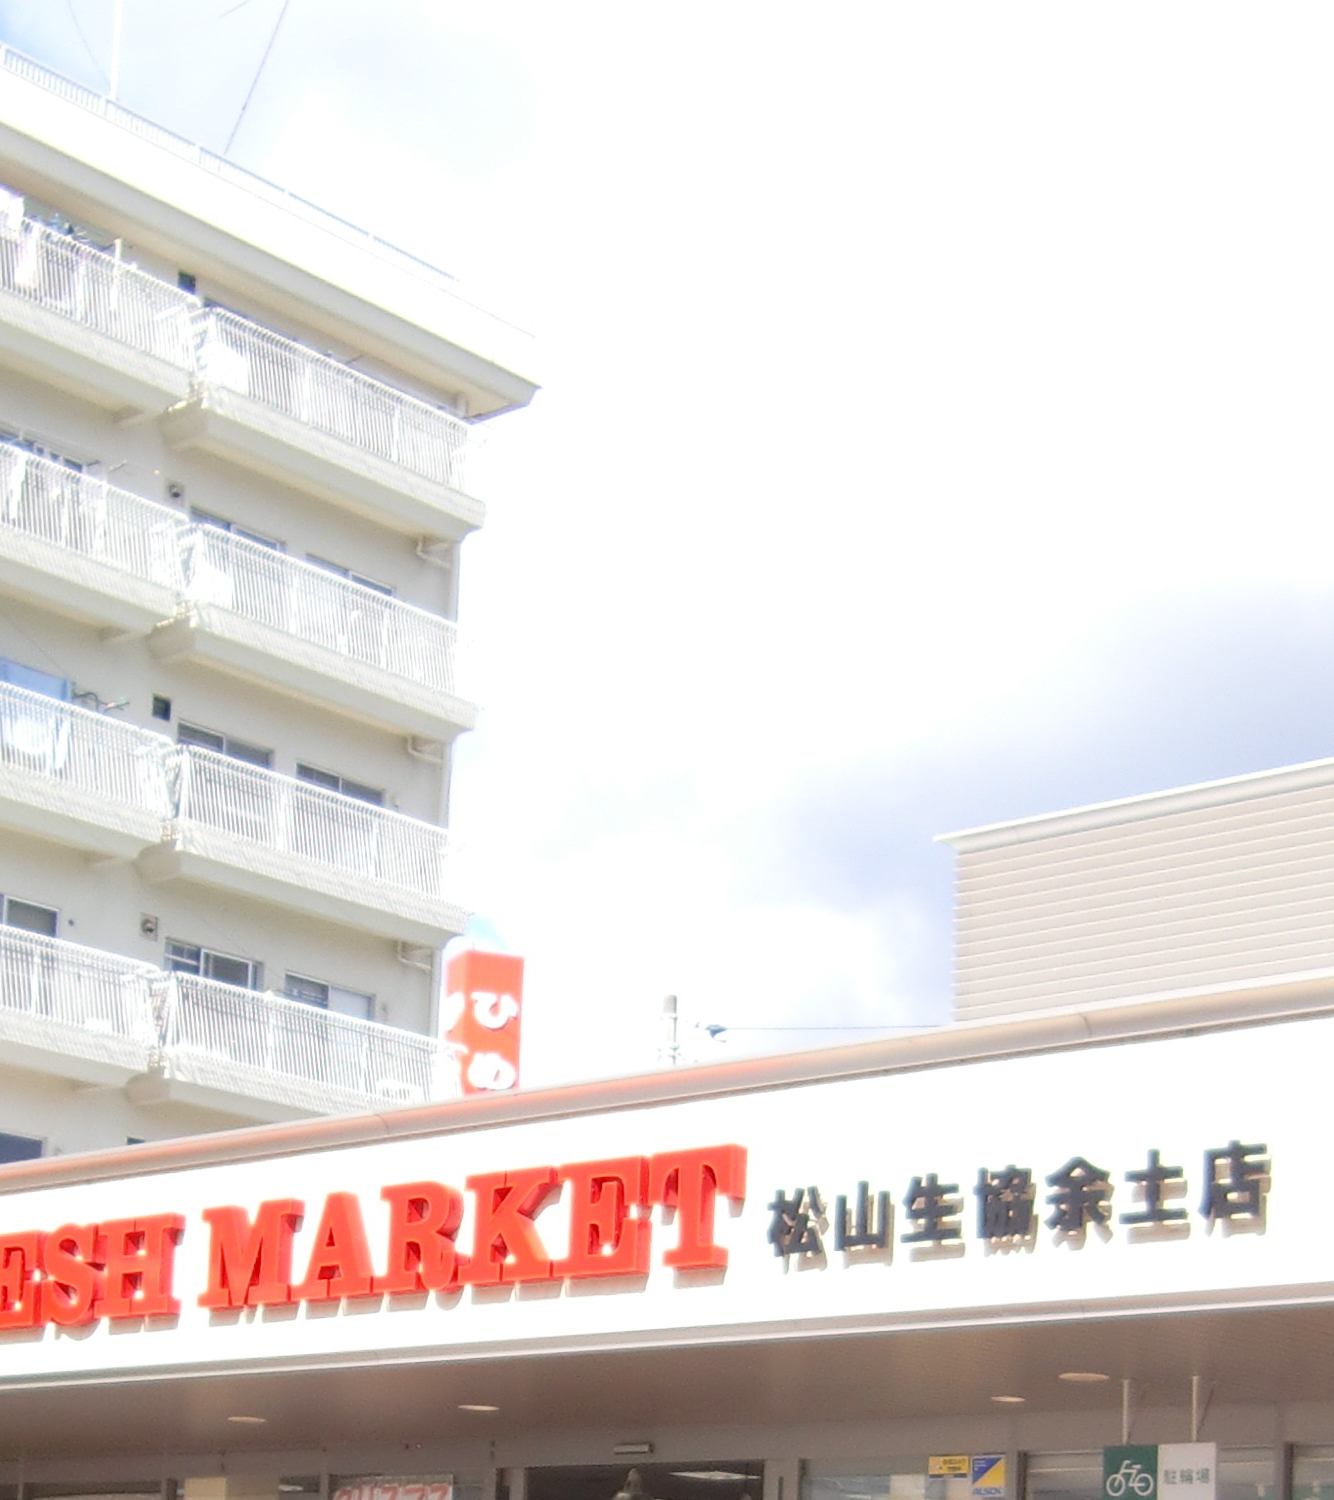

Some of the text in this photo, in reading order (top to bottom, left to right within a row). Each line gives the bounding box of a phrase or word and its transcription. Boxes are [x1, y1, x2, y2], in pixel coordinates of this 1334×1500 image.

[199, 1144, 748, 1308] MARKET
[767, 1140, 1269, 1258] 松山生協余土店
